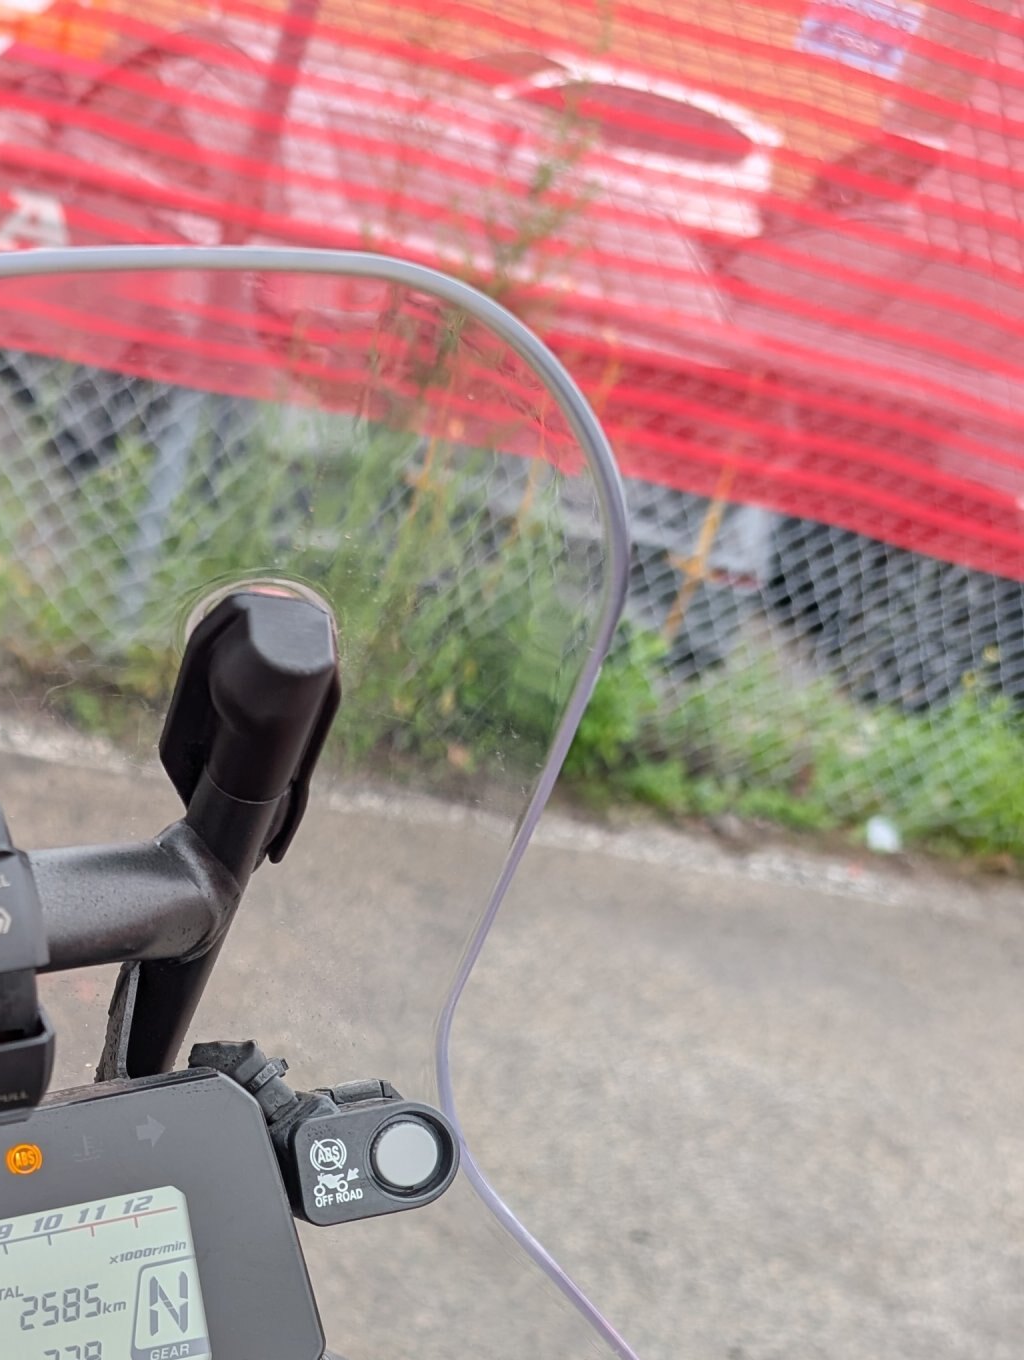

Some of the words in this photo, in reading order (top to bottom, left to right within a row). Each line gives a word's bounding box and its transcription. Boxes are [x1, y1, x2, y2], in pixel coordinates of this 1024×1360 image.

[13, 1149, 35, 1166] ABS
[317, 1145, 340, 1162] ABS
[122, 1195, 154, 1215] 12
[315, 1195, 333, 1208] OFF
[336, 1189, 363, 1204] ROAD
[32, 1214, 63, 1233] 10
[77, 1205, 106, 1224] 11
[19, 1283, 101, 1331] 2585
[103, 1300, 127, 1314] km
[148, 1271, 189, 1336] N
[149, 1344, 190, 1360] GEAR
